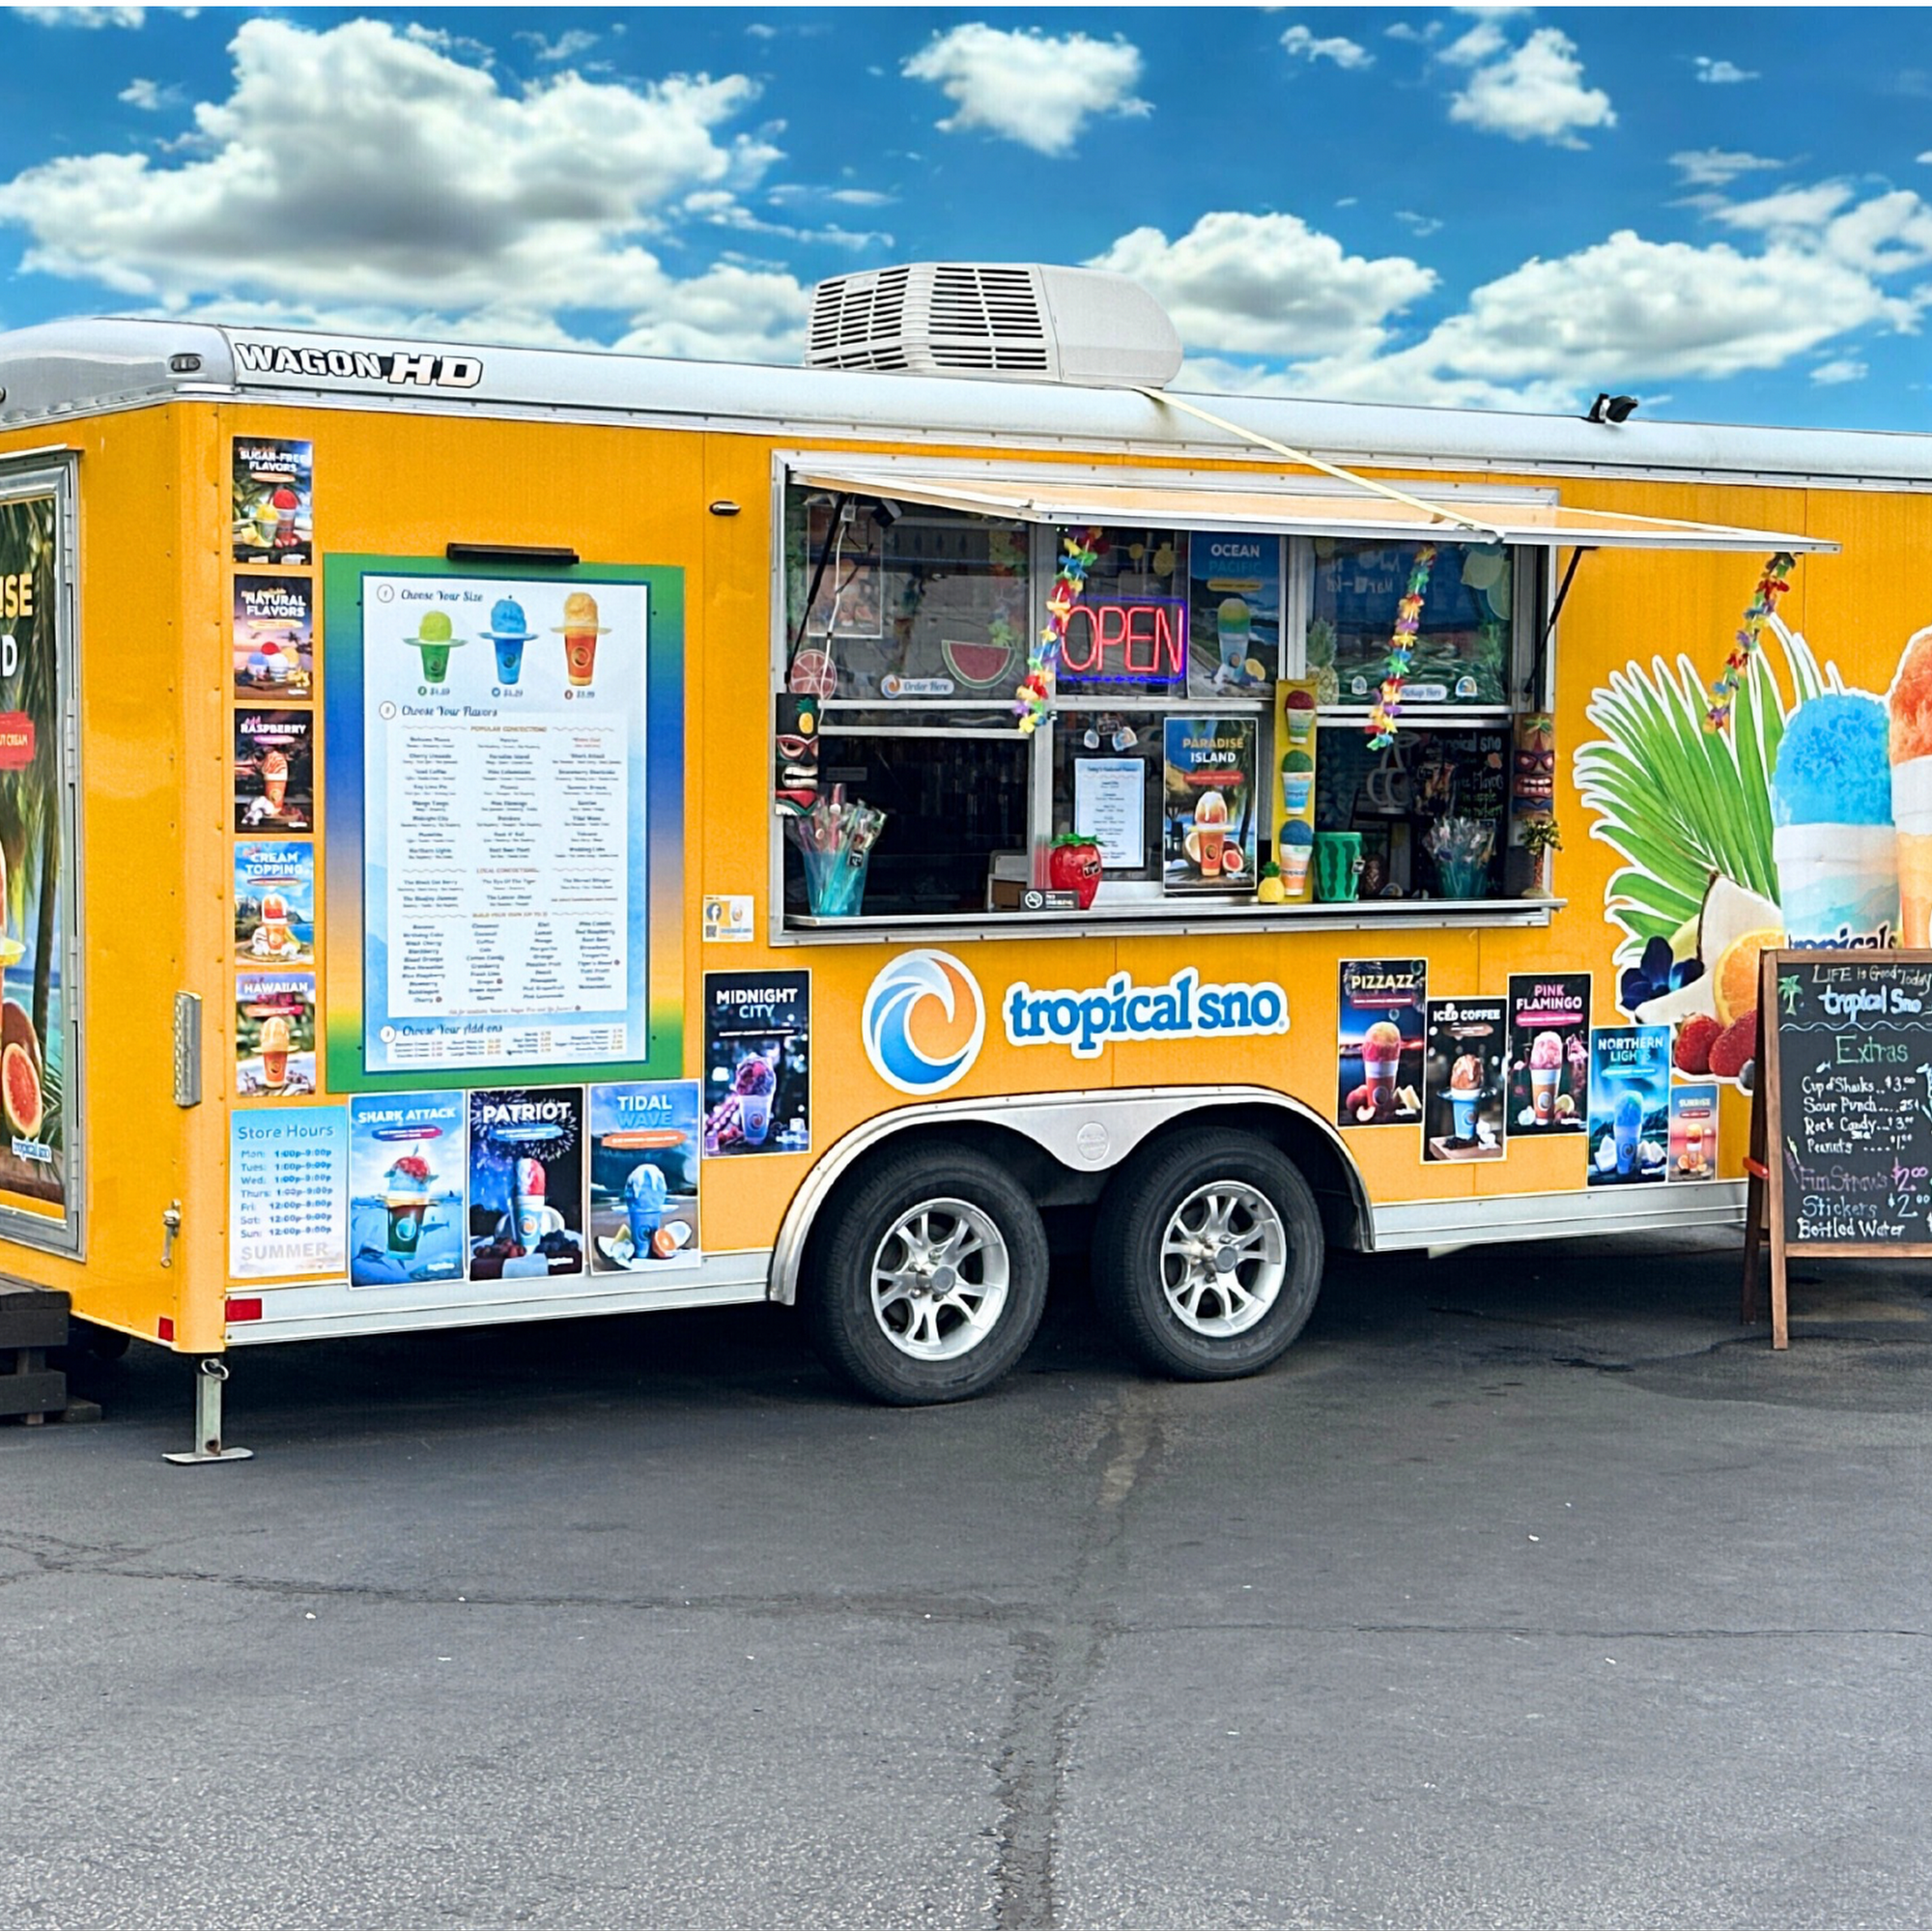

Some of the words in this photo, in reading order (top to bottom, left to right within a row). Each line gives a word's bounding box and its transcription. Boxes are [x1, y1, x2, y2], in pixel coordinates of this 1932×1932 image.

[235, 343, 383, 379] WAGON
[387, 353, 483, 388] HD
[240, 450, 307, 464] SUGAR-FREE
[249, 461, 298, 472] FLAVORS
[1210, 544, 1260, 557] OCEAN
[1208, 560, 1262, 574] PACIFIC
[245, 593, 306, 607] NATURAL
[463, 591, 483, 602] Size
[246, 606, 305, 617] FLAVORS
[1061, 605, 1183, 672] OPEN
[464, 706, 497, 717] Flavors
[241, 724, 306, 734] RASPBERRY
[1182, 737, 1244, 749] PARADISE
[1190, 752, 1236, 763] ISLAND
[251, 852, 298, 864] CREAM
[245, 864, 303, 875] TOPPING
[1811, 964, 1852, 982] LIFE
[244, 982, 308, 994] HAWAIIAN
[1351, 974, 1415, 989] PIZZAZZ
[716, 988, 798, 1005] MIDNIGHT
[1534, 983, 1565, 997] PINK
[1516, 996, 1582, 1010] FLAMINGO
[1818, 984, 1888, 1022] tropical
[739, 1005, 776, 1019] CITY
[1009, 975, 1192, 1050] tropical
[1198, 989, 1281, 1030] sno
[1434, 1009, 1459, 1022] ICED
[1461, 1009, 1501, 1022] COFFEE
[1598, 1037, 1663, 1051] NORTHERN
[1835, 1035, 1909, 1064] Extras
[1802, 1076, 1824, 1098] Cup
[617, 1094, 672, 1111] TIDAL
[1804, 1096, 1837, 1113] Sour
[357, 1110, 403, 1123] SHARK
[406, 1107, 456, 1122] ATTACK
[483, 1102, 571, 1123] PATRIOT
[617, 1111, 672, 1128] WAVE
[1804, 1117, 1834, 1135] Rock
[1840, 1114, 1877, 1134] Candy
[239, 1126, 282, 1140] Store
[287, 1124, 333, 1138] Hours
[1802, 1195, 1878, 1217] Stickers
[1858, 1219, 1905, 1237] Water
[241, 1242, 329, 1261] SUMMER
